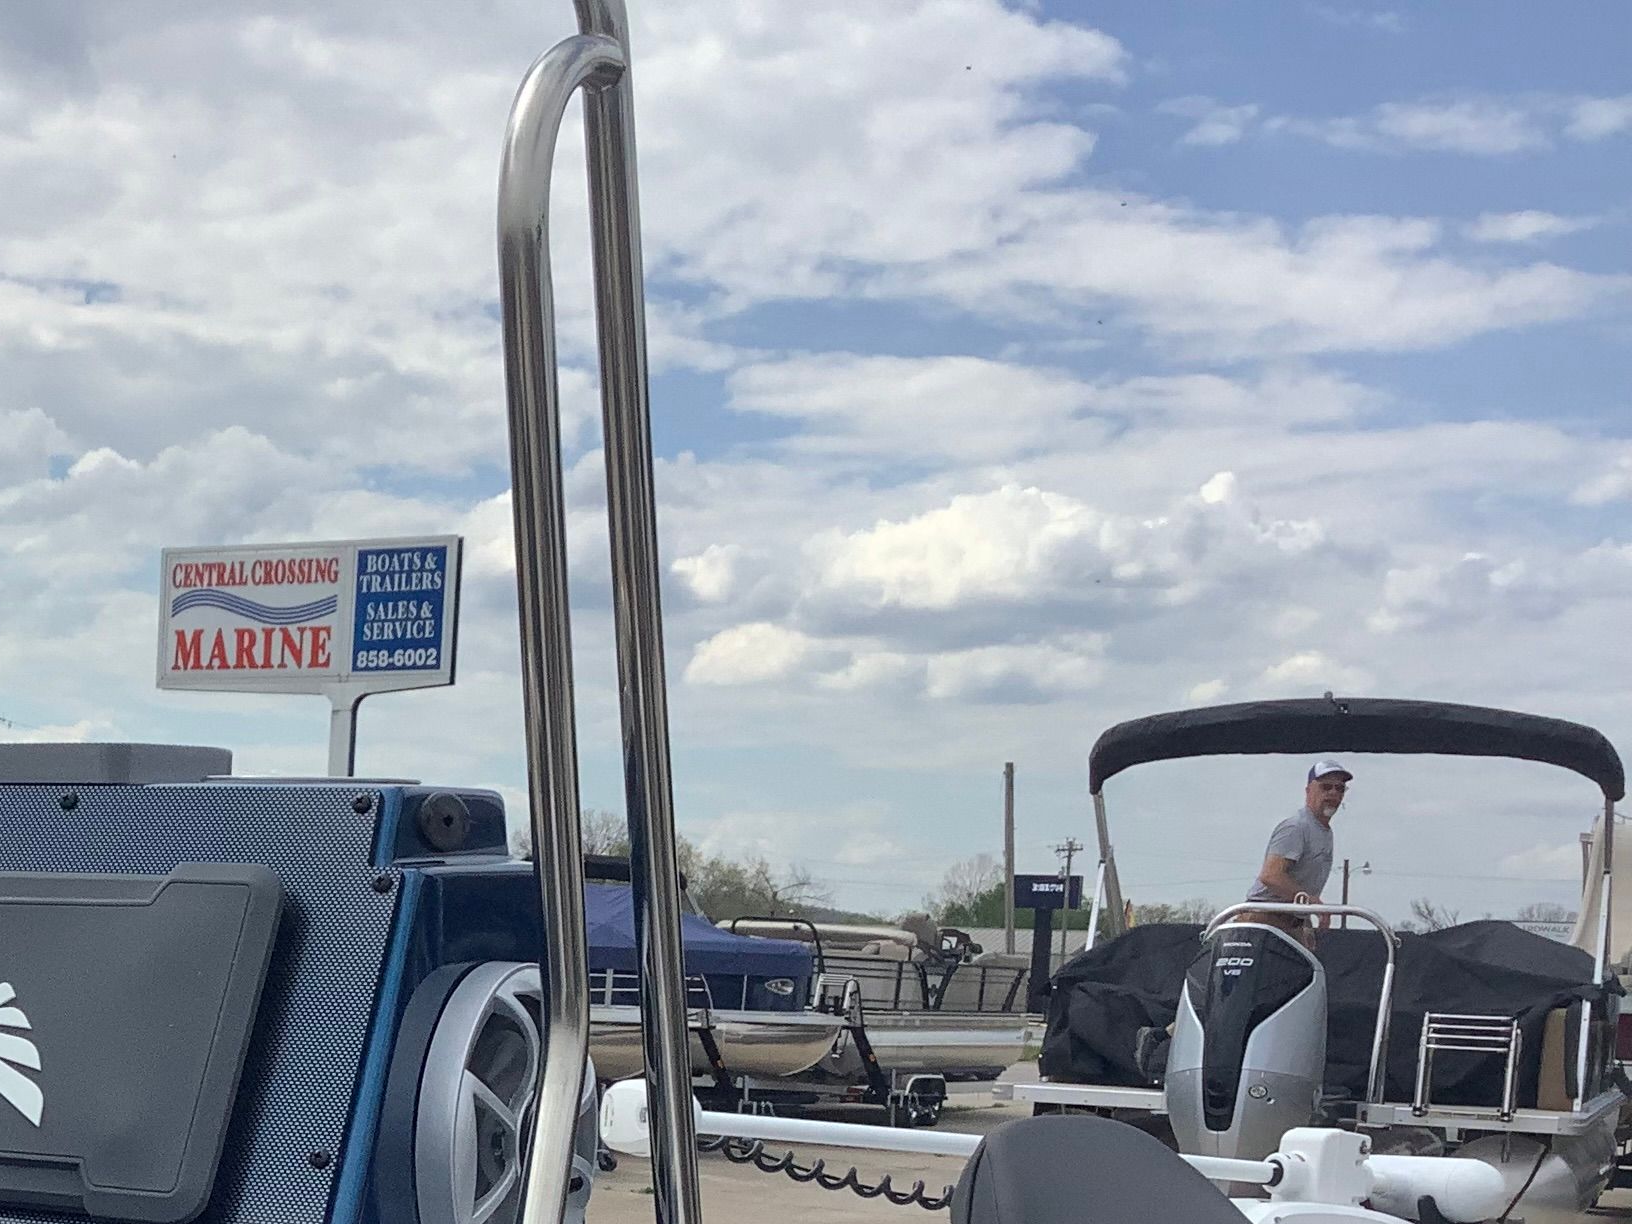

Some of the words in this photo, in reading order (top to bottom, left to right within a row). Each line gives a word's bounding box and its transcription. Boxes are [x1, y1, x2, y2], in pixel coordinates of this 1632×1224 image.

[172, 561, 248, 588] CENTRAL
[251, 557, 339, 586] CROSSING
[366, 552, 420, 573] BOATS
[424, 551, 437, 570] &
[359, 571, 442, 594] TRAILERS
[366, 601, 417, 621] SALES
[420, 600, 433, 619] &
[362, 619, 435, 641] SERVICE
[171, 626, 332, 671] MARINE
[357, 648, 437, 668] 858-6002
[1216, 957, 1254, 967] 200
